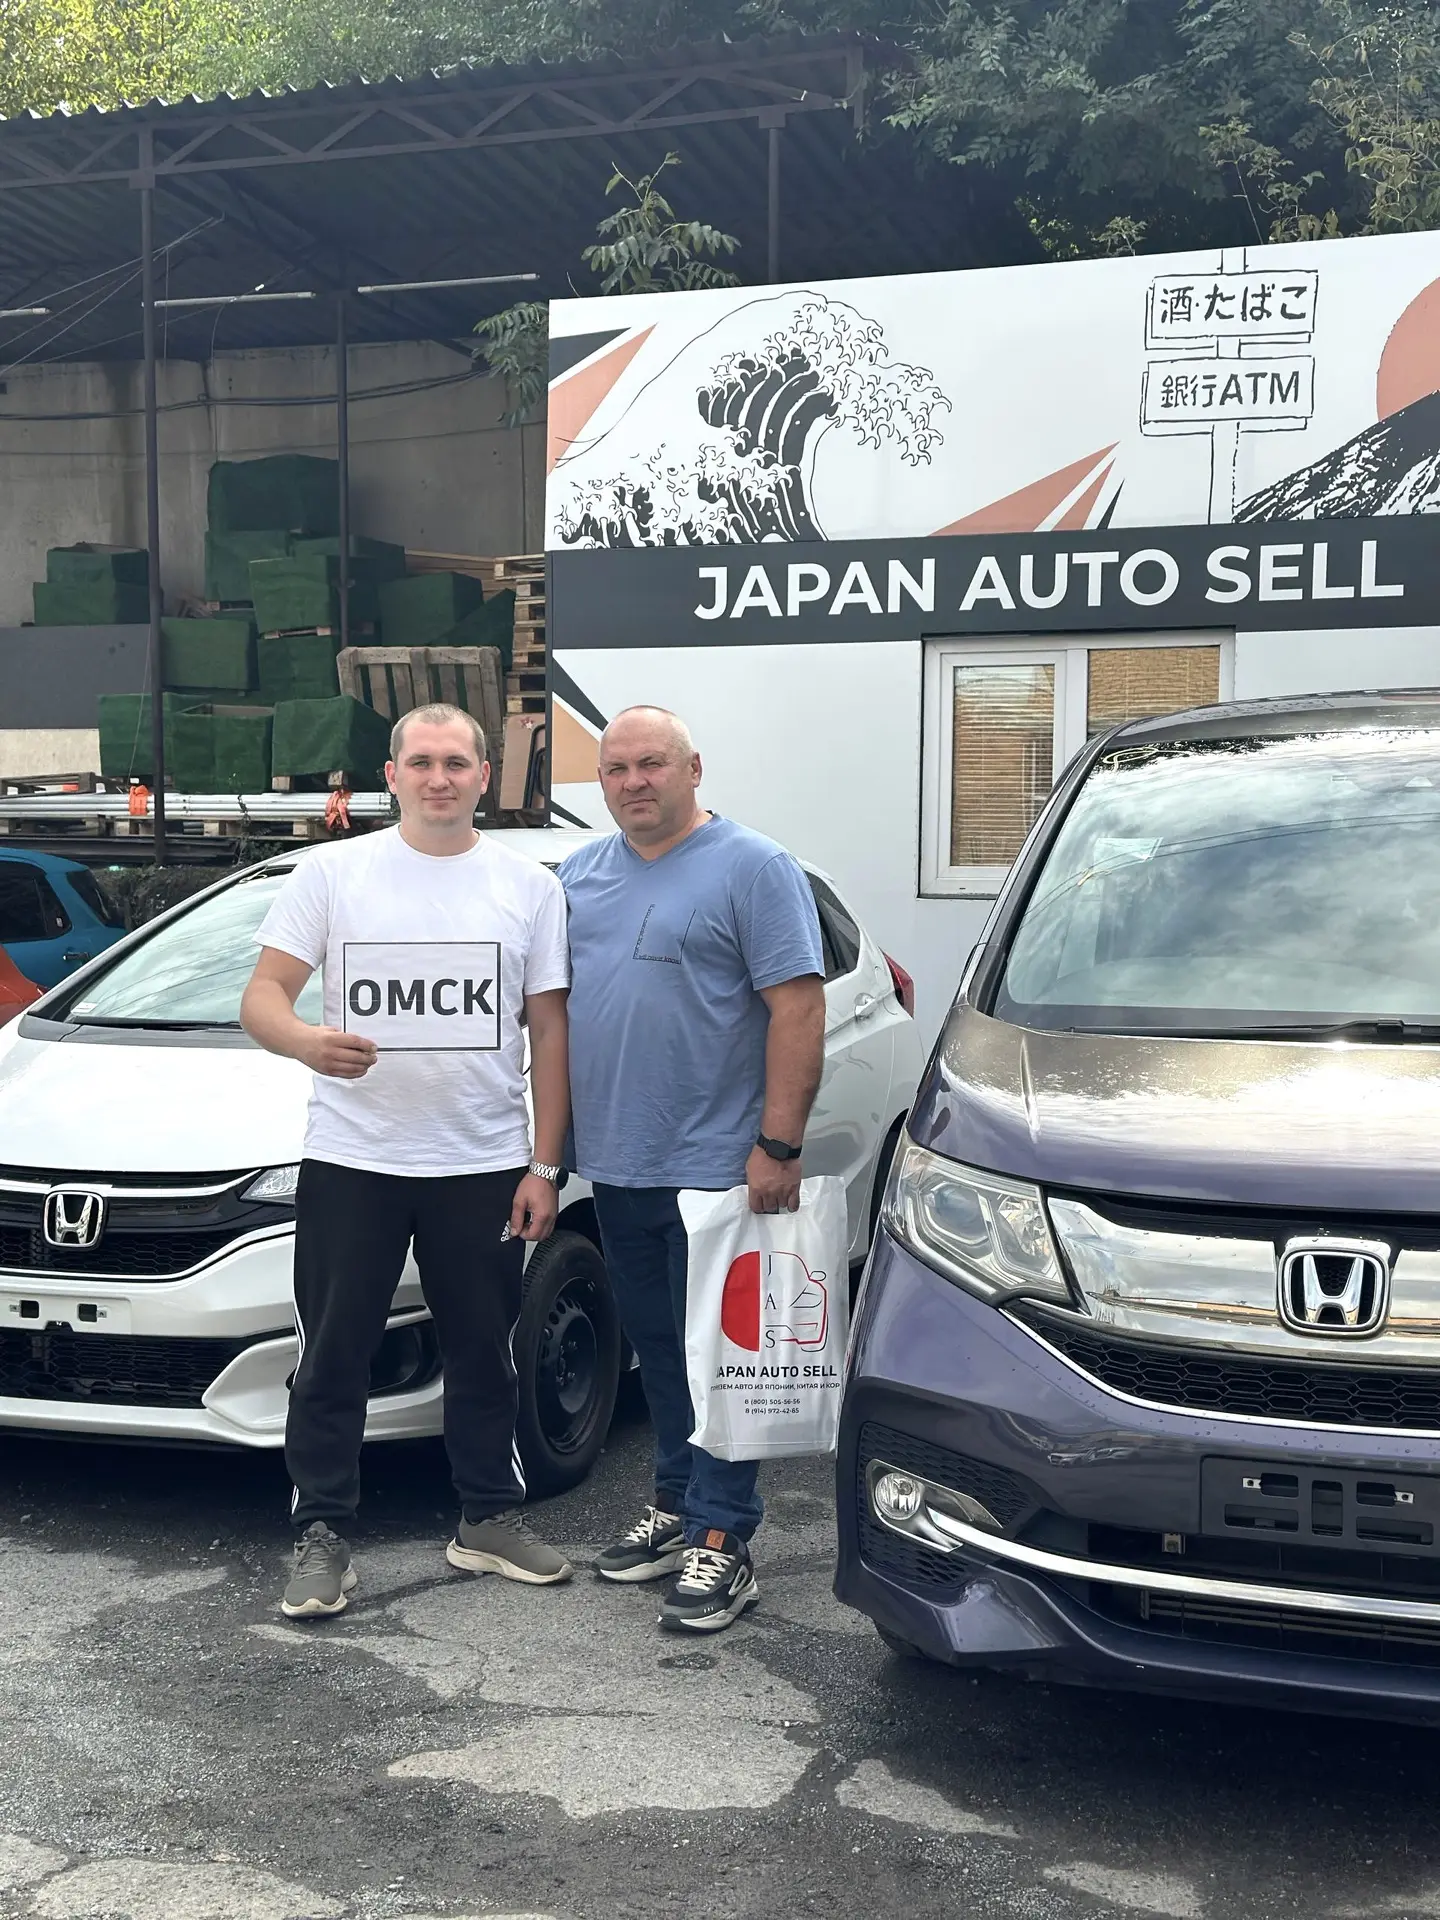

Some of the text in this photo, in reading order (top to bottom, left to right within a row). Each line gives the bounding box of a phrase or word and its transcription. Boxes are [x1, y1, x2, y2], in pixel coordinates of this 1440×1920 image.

[1160, 371, 1300, 408] 銀行ATM
[693, 540, 1404, 620] JAPAN AUTO SELL
[349, 978, 495, 1017] ОМСК
[760, 1365, 799, 1378] AUTO
[803, 1365, 837, 1377] SELL
[797, 1382, 819, 1390] КИТАЯ
